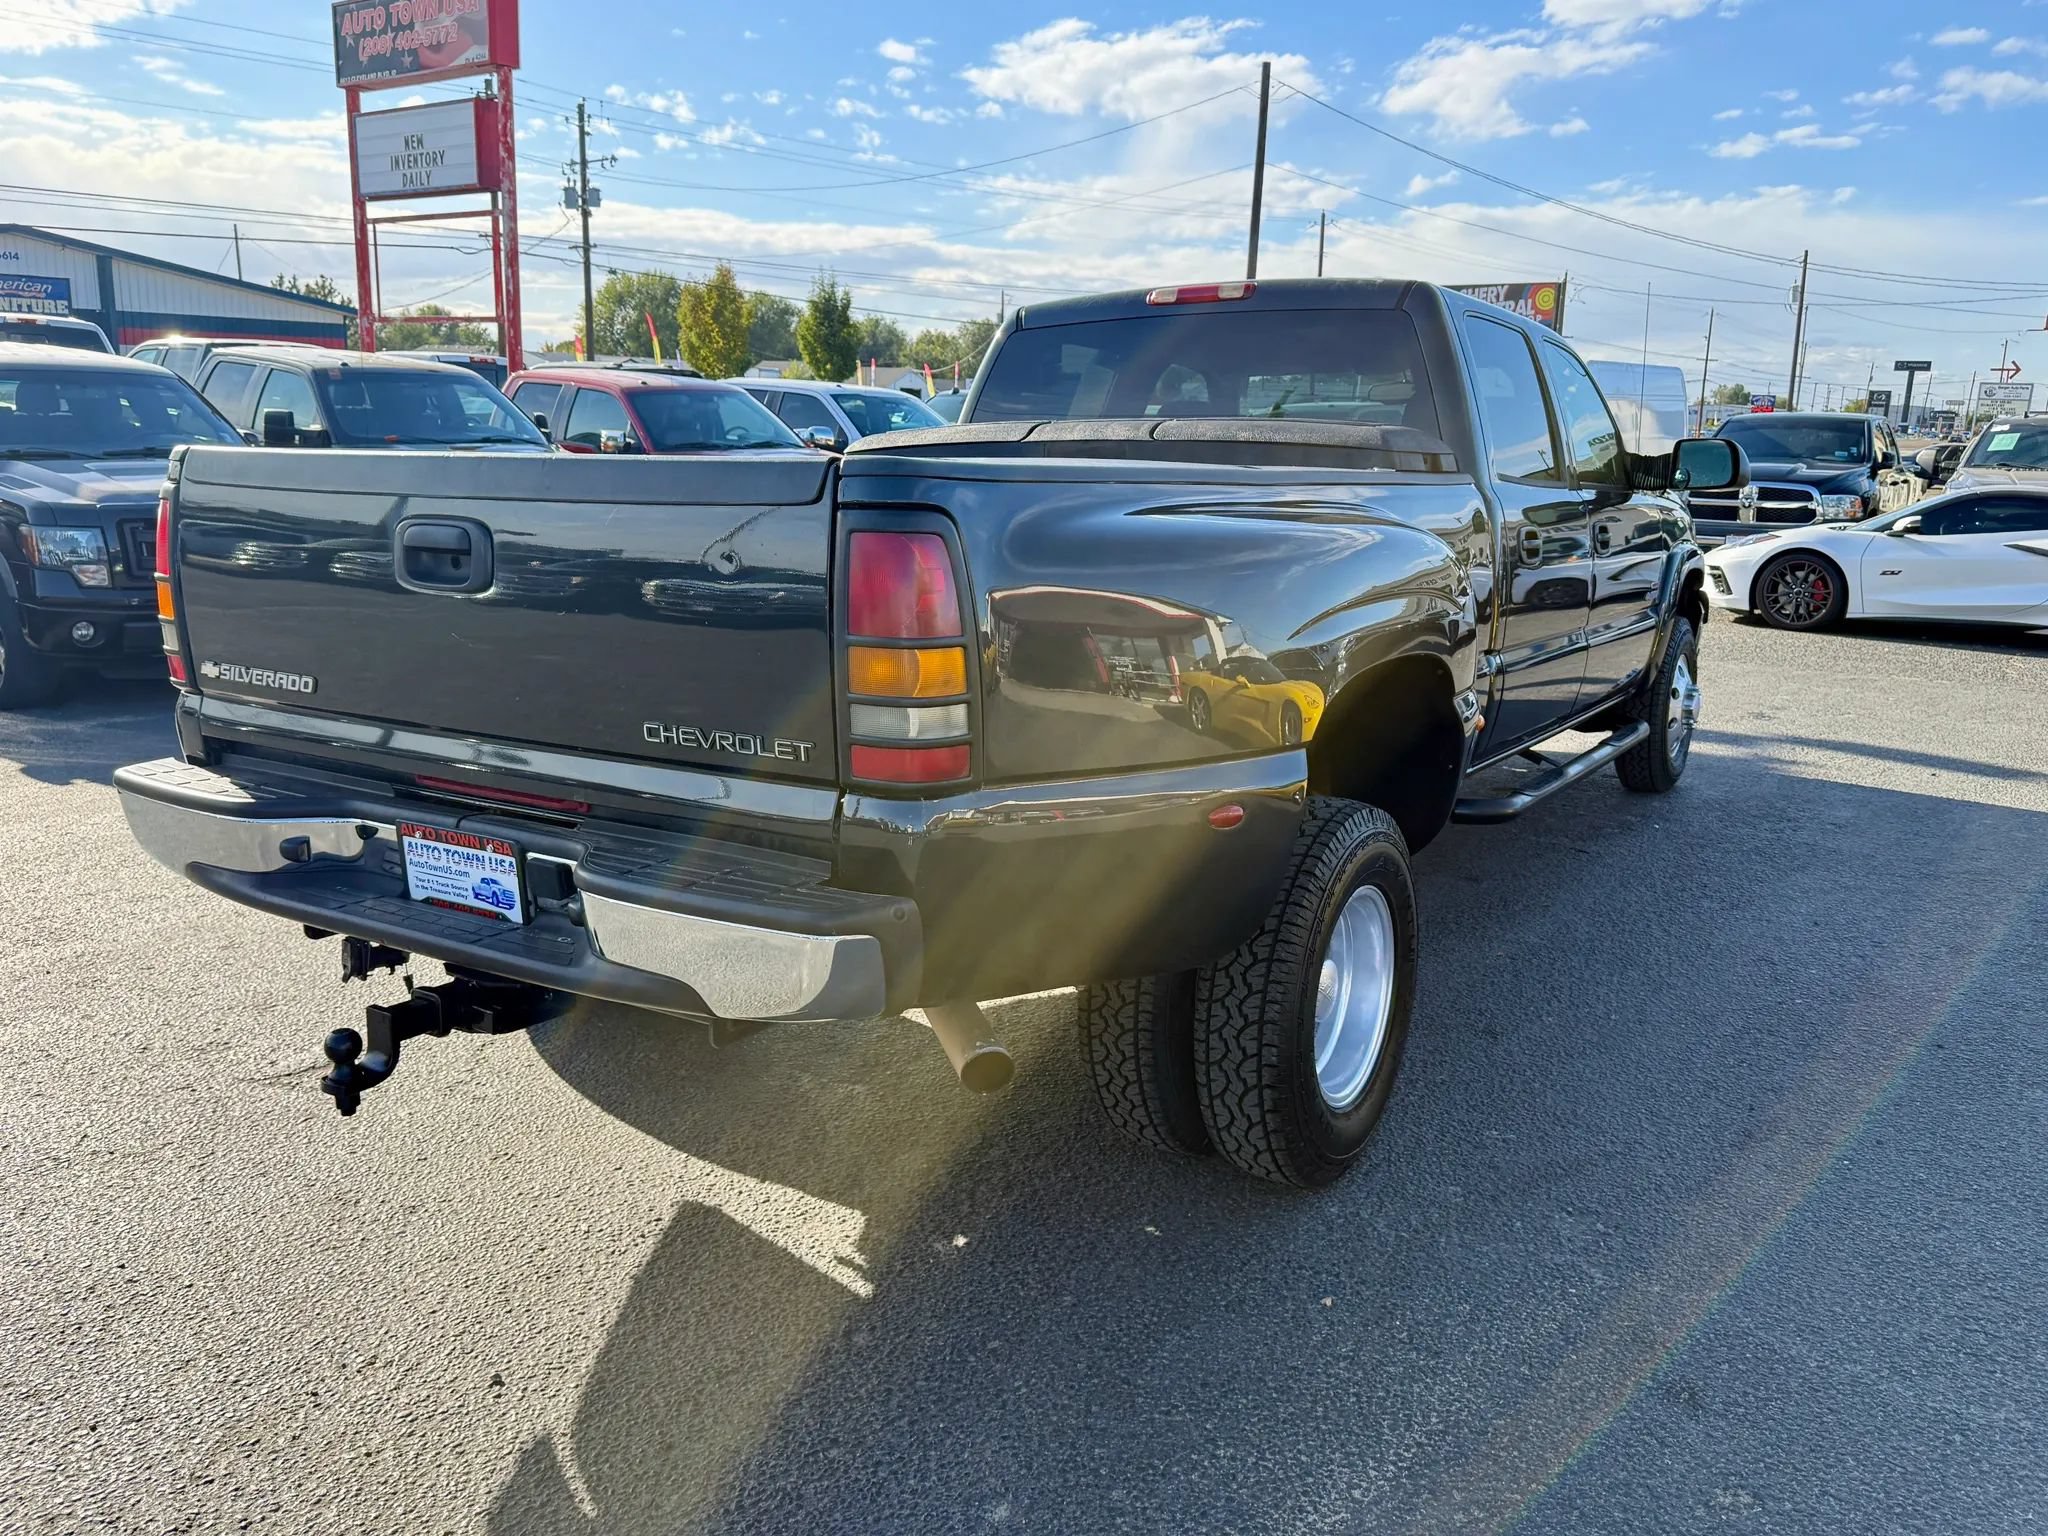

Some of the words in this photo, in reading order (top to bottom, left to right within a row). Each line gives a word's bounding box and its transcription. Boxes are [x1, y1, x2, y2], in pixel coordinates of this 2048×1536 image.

[341, 6, 386, 36] AUTO
[389, 0, 439, 27] TOWN
[443, 0, 480, 17] USA
[359, 34, 392, 59] (208)
[395, 22, 458, 50] 402-5772
[403, 133, 425, 151] NEW
[390, 150, 445, 172] INVENTORY
[402, 170, 432, 188] DAILY
[0, 251, 19, 261] 614
[220, 663, 315, 693] SILVERADO
[642, 721, 815, 762] CHEVROLET
[400, 823, 436, 840] AUTO
[438, 830, 481, 849] TOWN
[484, 838, 512, 856] USA
[407, 841, 442, 862] AUTO
[443, 848, 486, 871] TOWN
[488, 856, 517, 878] USA
[408, 858, 471, 878] AutoTownUS.com
[429, 885, 451, 896] Treasure
[436, 880, 449, 888] Truck
[450, 883, 469, 892] Source
